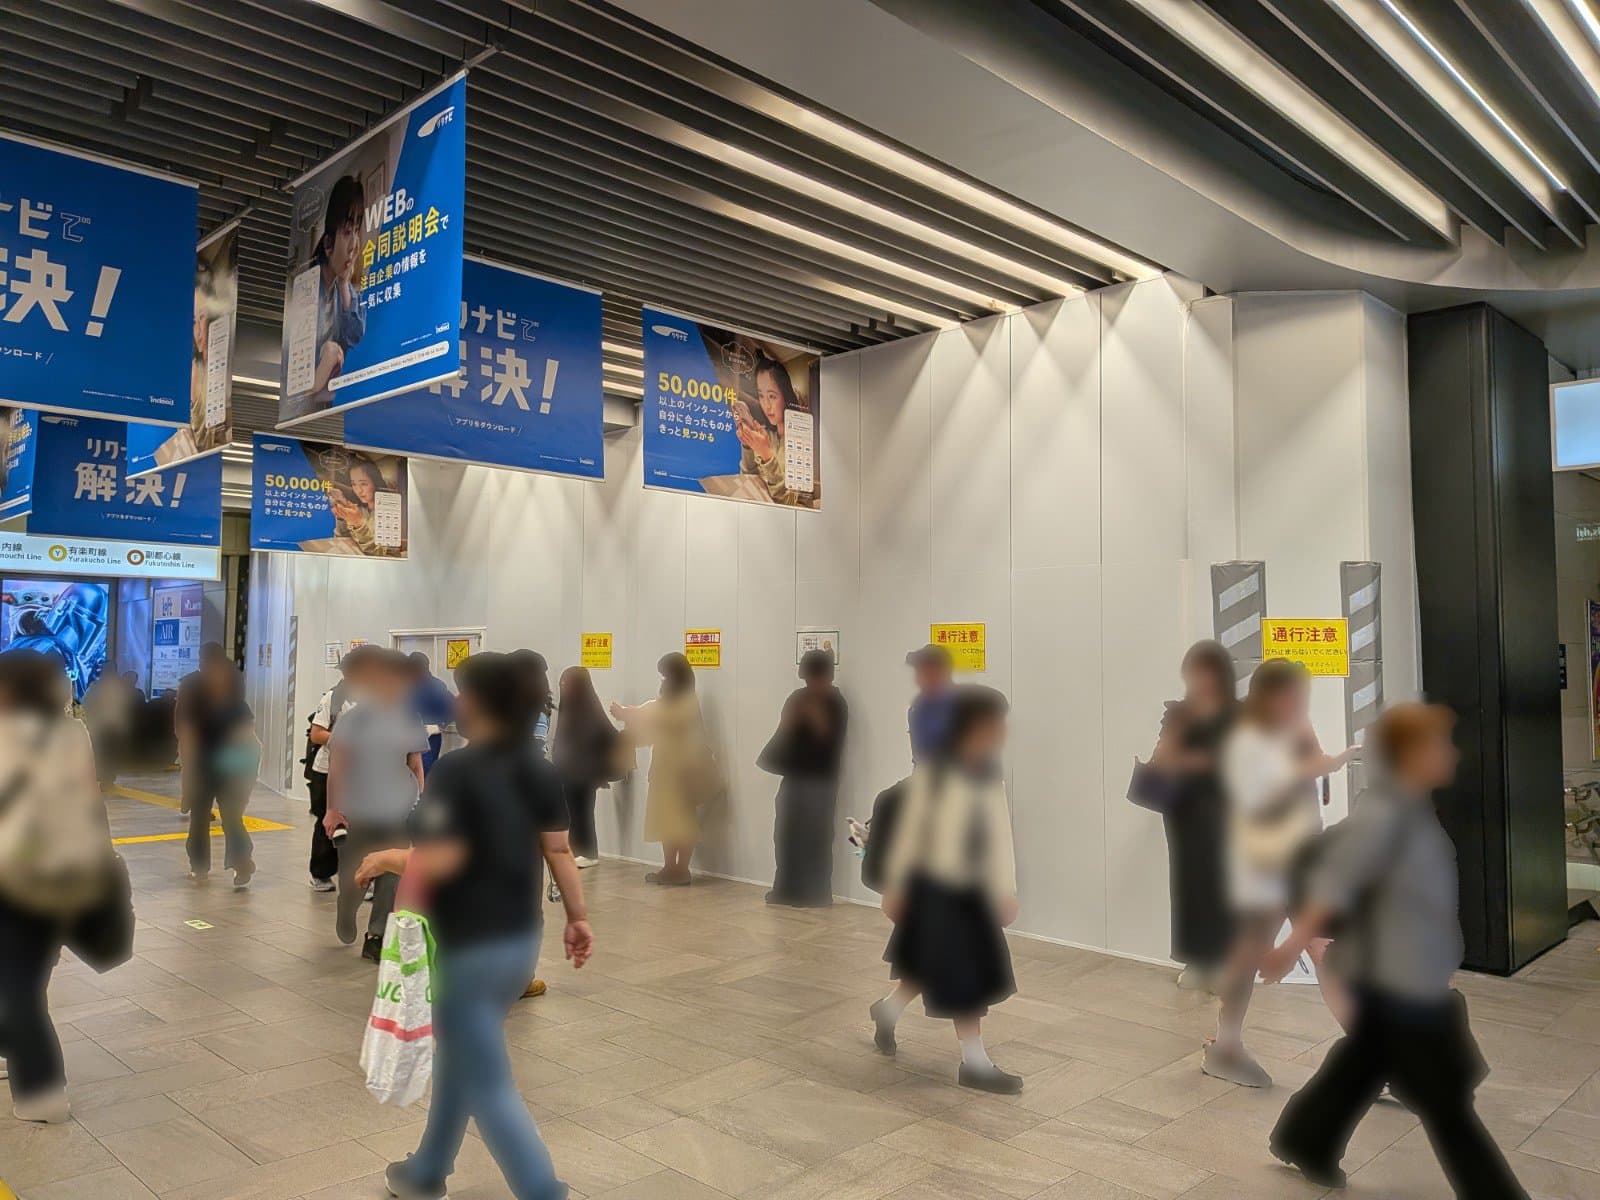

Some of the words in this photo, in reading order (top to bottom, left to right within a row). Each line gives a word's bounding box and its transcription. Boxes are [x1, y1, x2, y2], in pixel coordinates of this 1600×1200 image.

[364, 188, 415, 232] WEBの
[361, 206, 449, 268] 合同説明会で
[360, 249, 427, 292] 注目企業の情報を
[360, 282, 402, 309] 一気に収集
[0, 346, 43, 361] ンロード
[658, 372, 737, 407] 50,000件
[659, 395, 740, 421] 以上のインターンから
[659, 410, 733, 433] 自分に合ったものが
[659, 424, 715, 443] きっと見つかる
[264, 474, 333, 492] 50,000件
[26, 553, 42, 561] Line
[68, 546, 108, 557] 有楽町線
[68, 555, 105, 564] Yurakucho
[936, 630, 980, 643] 通行注意
[1272, 626, 1338, 643] 通行注意
